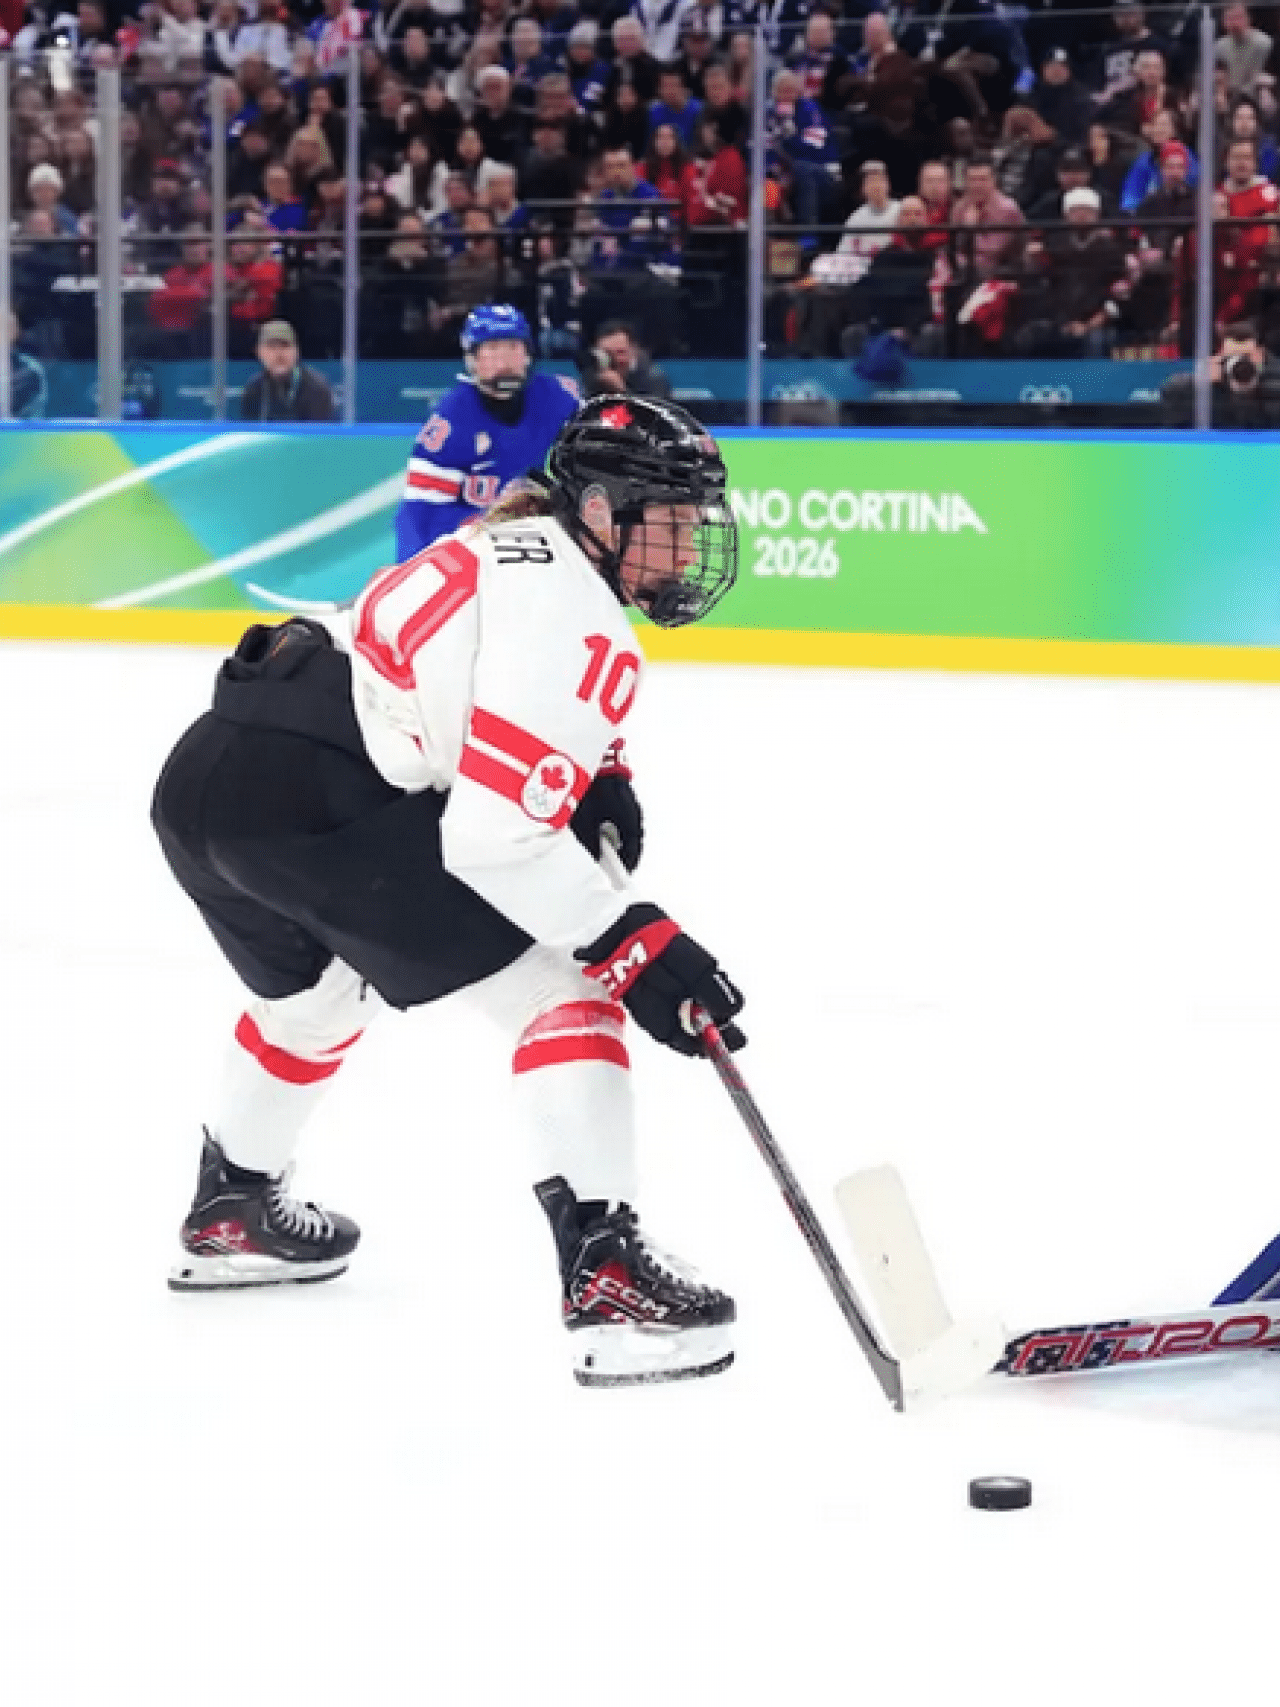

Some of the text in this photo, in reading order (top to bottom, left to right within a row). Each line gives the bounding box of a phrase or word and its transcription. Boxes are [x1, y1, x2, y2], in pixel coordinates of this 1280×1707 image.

[798, 487, 988, 534] CORTINA
[752, 535, 840, 578] 2026
[576, 632, 641, 726] 10
